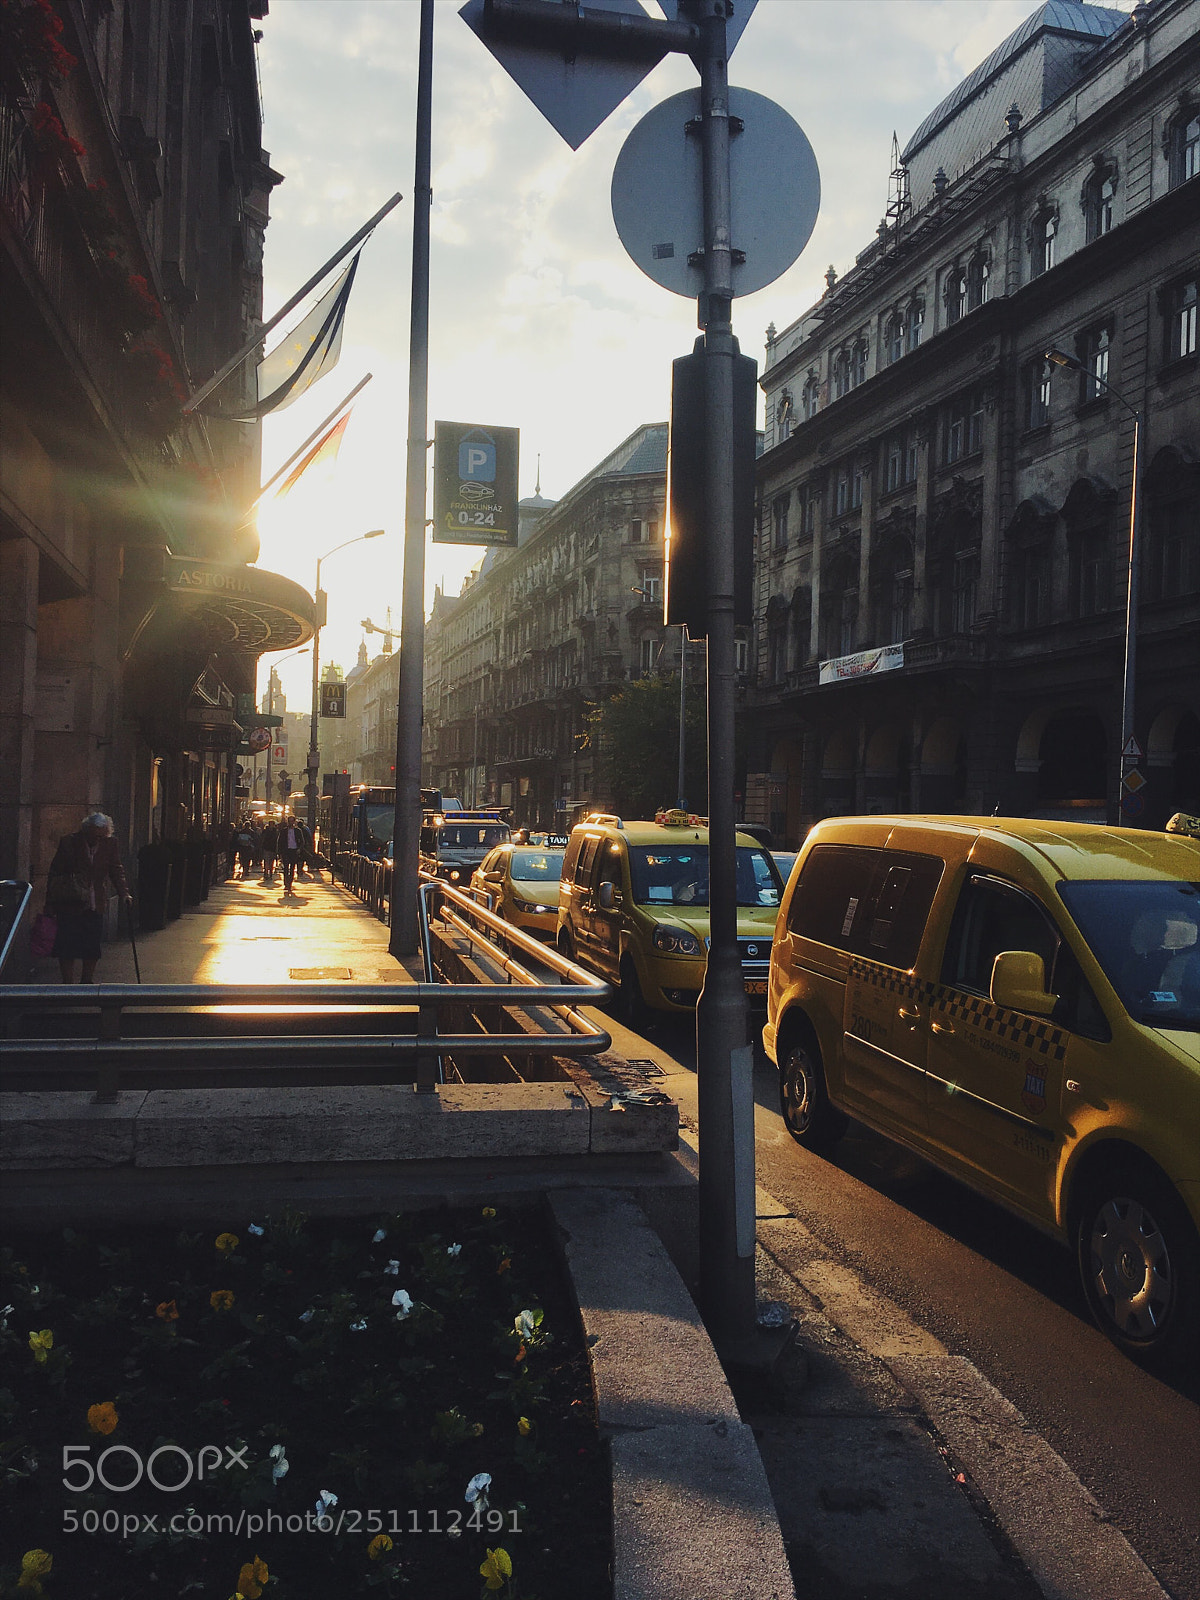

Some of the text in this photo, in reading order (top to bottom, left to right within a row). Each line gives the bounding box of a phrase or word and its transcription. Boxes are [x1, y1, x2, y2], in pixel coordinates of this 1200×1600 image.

[468, 449, 487, 474] P
[450, 502, 503, 513] FRANKLINHÁZ
[458, 511, 495, 526] 0-24
[177, 570, 252, 593] ASTORIA
[550, 836, 567, 844] TAXI
[850, 1013, 872, 1040] 280
[1026, 1074, 1045, 1097] TAXI
